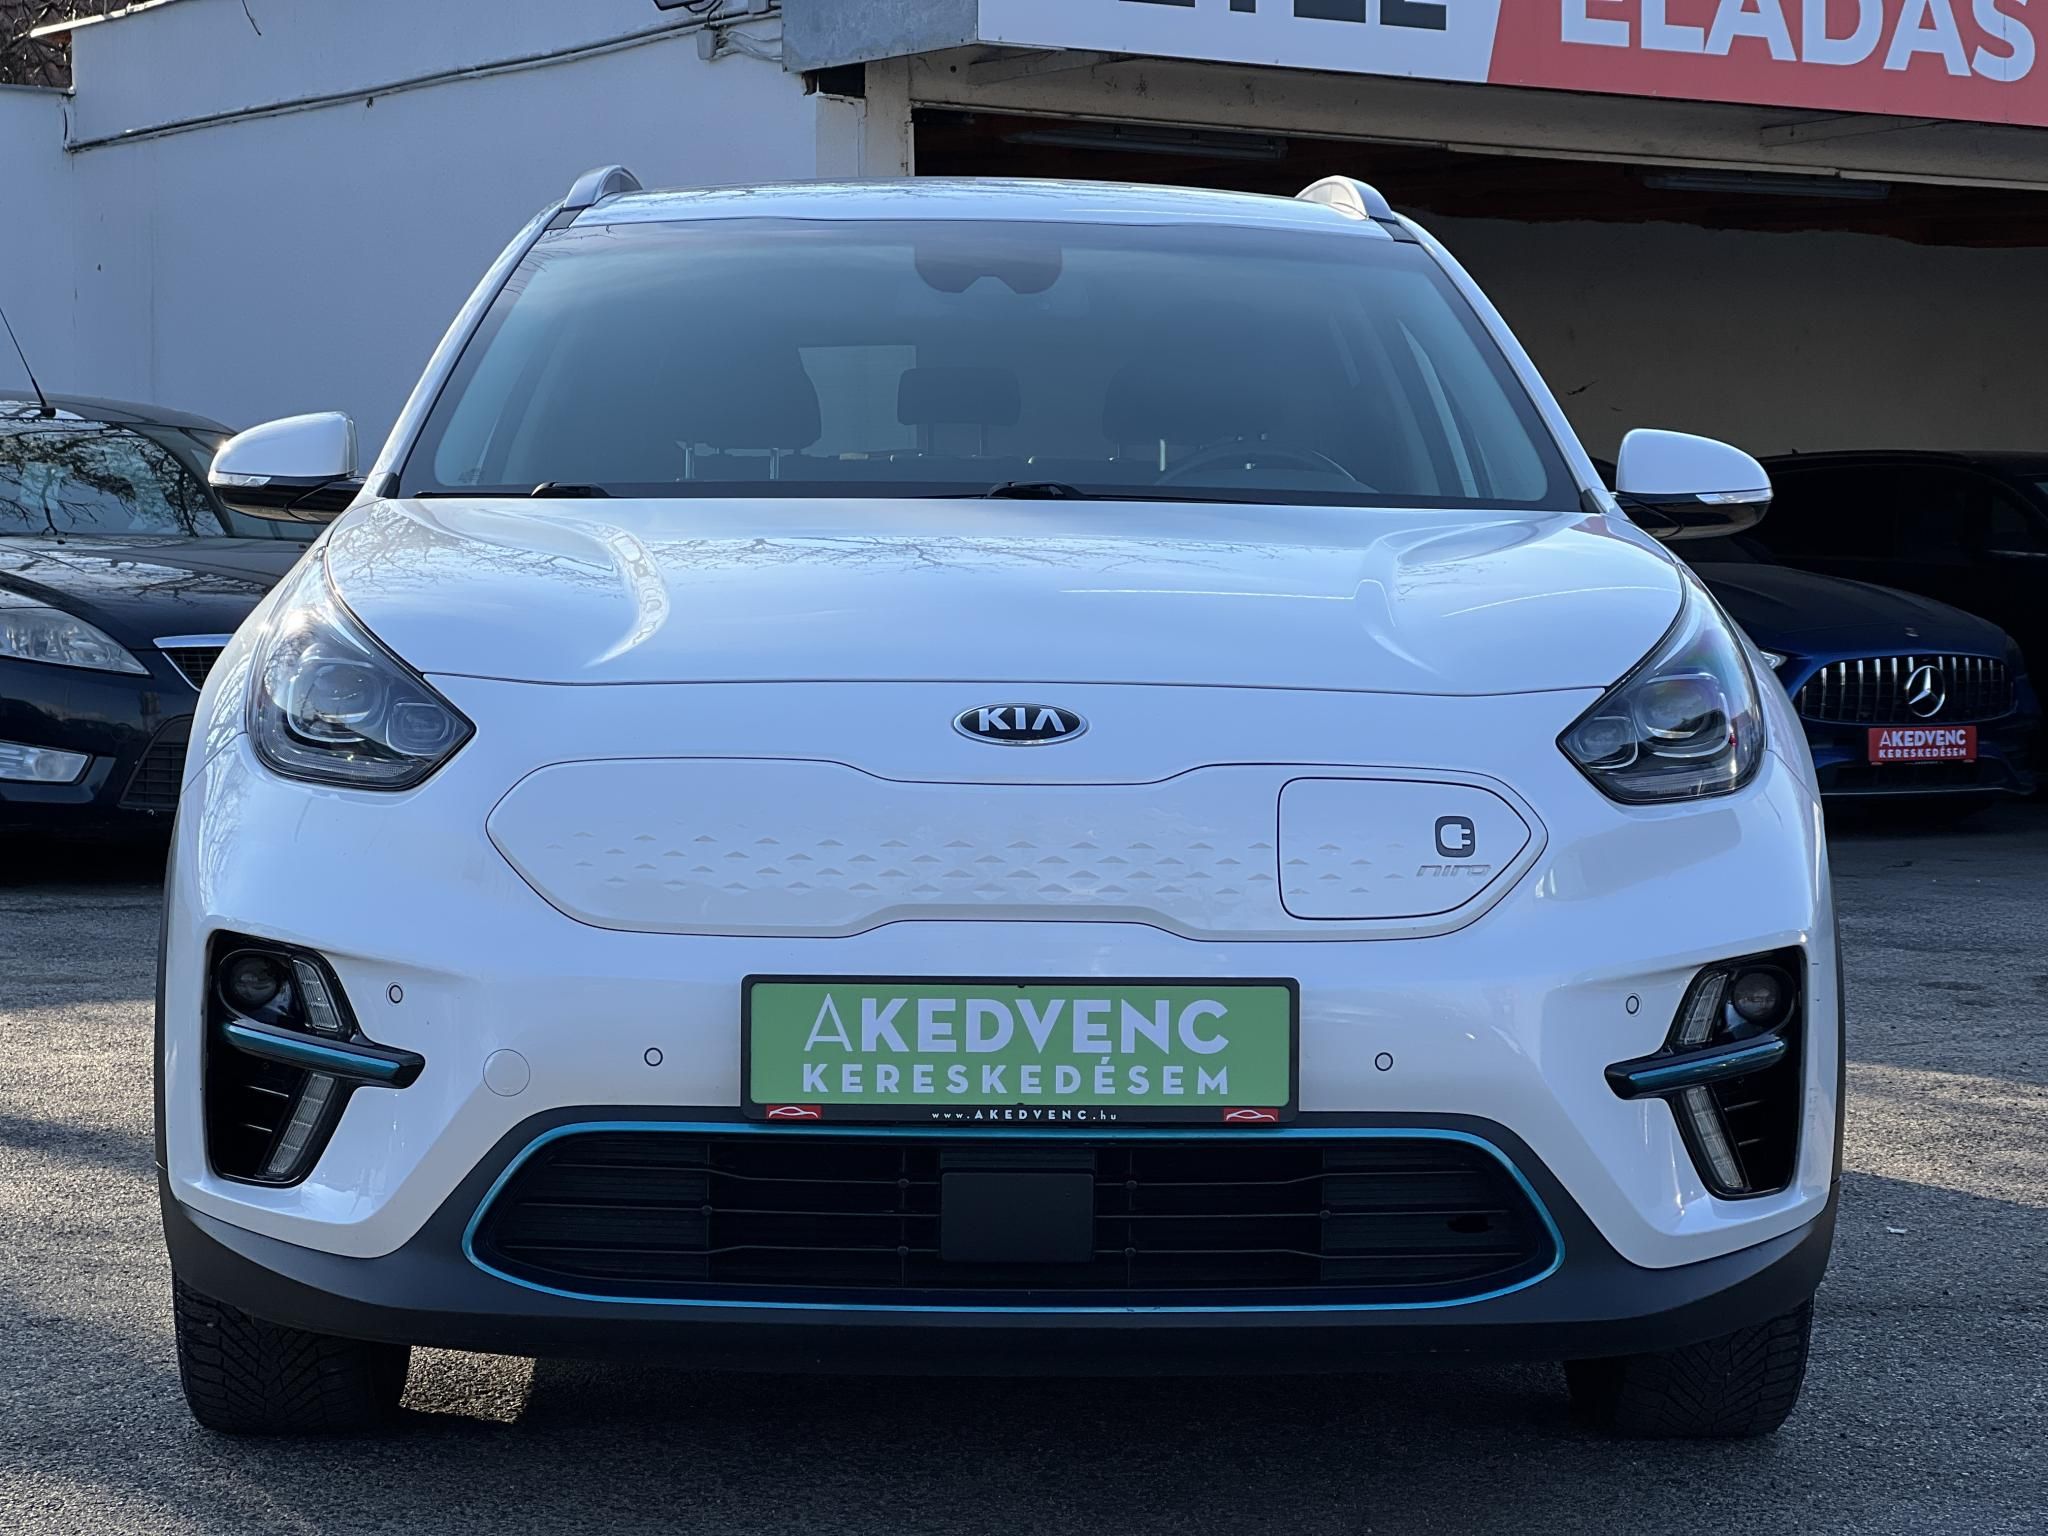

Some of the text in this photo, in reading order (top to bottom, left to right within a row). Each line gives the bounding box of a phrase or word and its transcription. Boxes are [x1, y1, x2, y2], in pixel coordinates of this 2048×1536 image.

[978, 707, 1066, 732] KIA
[1879, 729, 1967, 747] AKEDVENC
[1878, 746, 1967, 758] KERESKEDÉSEM
[804, 993, 1229, 1054] AKEDVENC
[803, 1056, 1229, 1095] KERESKEDÉSEM
